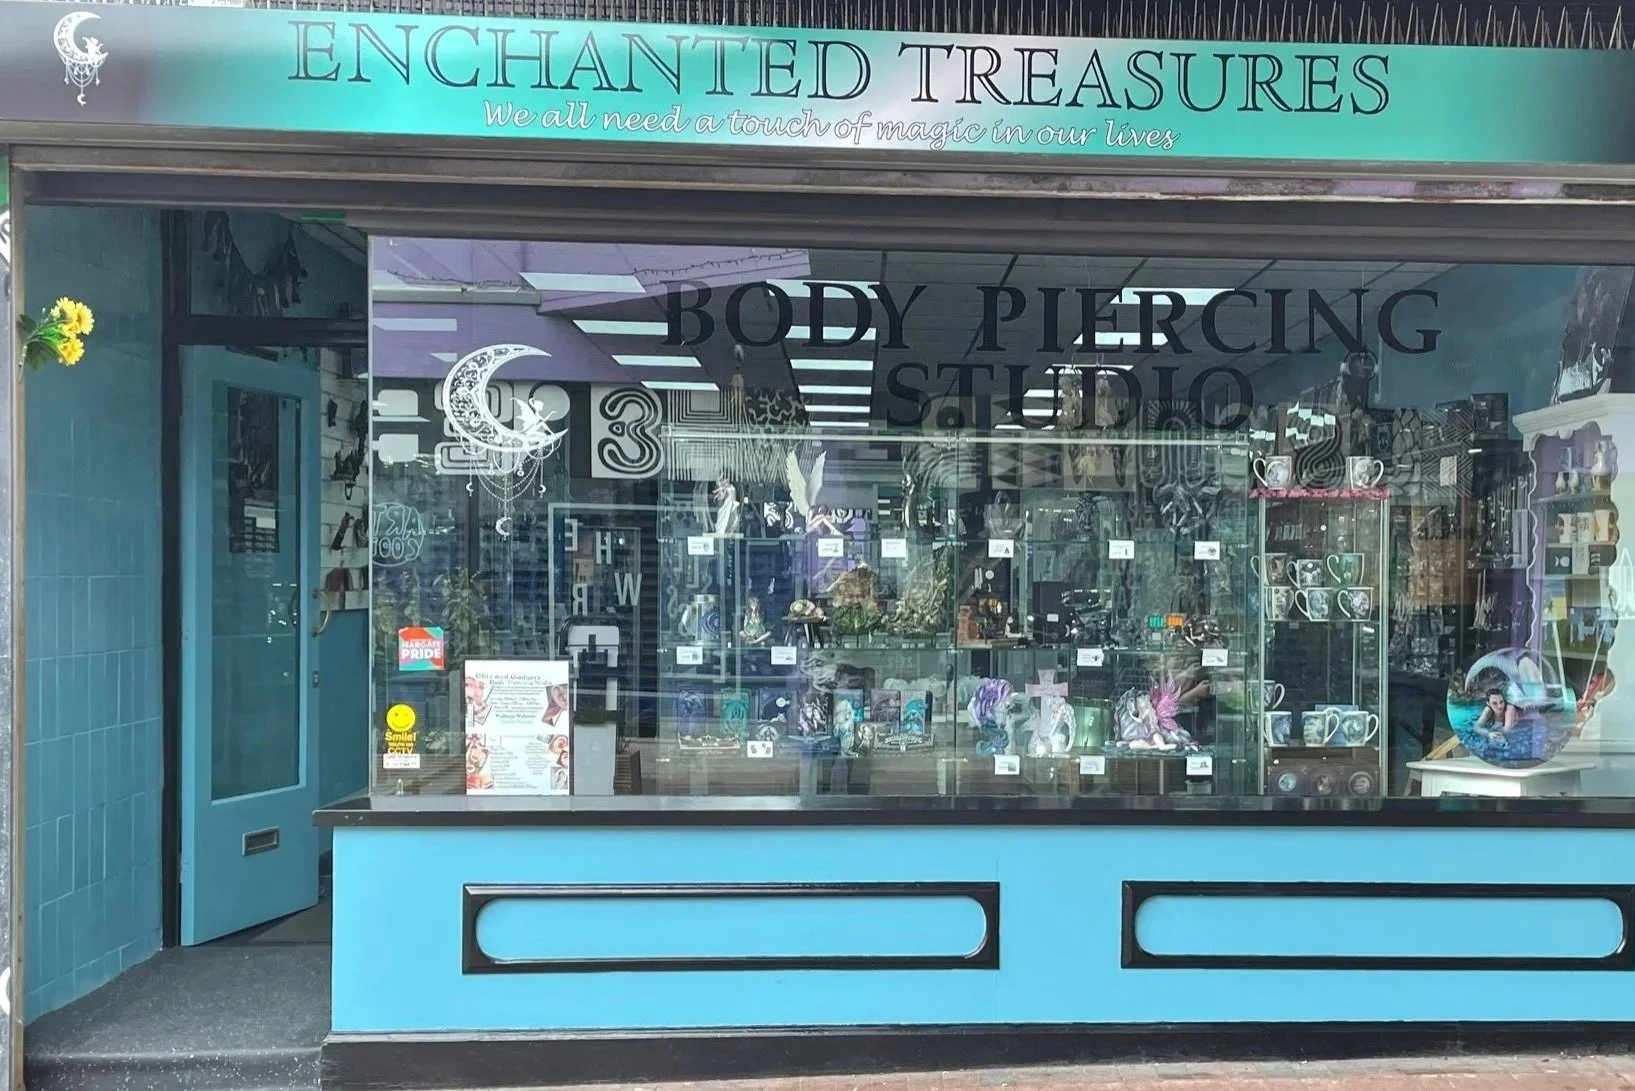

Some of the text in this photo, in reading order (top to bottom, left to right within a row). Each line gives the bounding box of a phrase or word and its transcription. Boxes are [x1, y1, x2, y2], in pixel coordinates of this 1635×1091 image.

[288, 19, 1391, 115] ENCHANTED TREASURES
[484, 100, 1182, 151] We all need a touch of magic in our lives
[662, 278, 1442, 356] BODY PIERCING
[886, 361, 1256, 430] STUDIO
[401, 648, 442, 660] PRIDE
[385, 731, 417, 742] Smile!
[387, 747, 413, 757] CCTV
